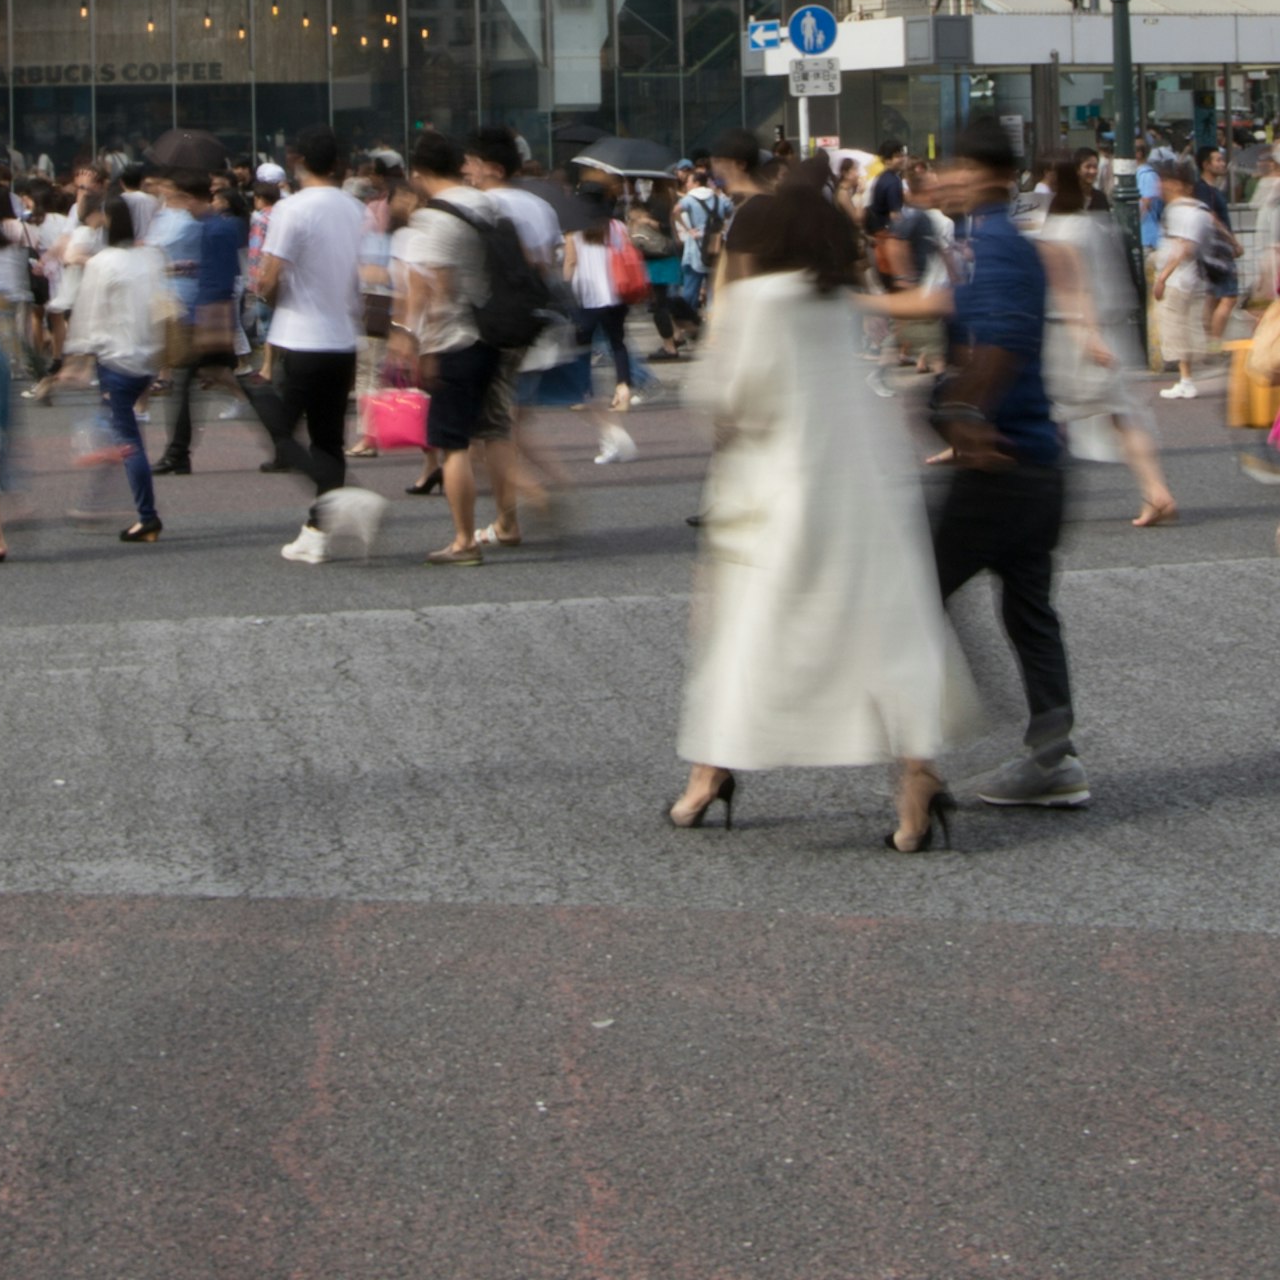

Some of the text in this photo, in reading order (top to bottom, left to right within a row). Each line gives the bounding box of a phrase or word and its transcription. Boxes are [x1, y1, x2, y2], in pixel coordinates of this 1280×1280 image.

[794, 61, 805, 70] 15
[122, 61, 224, 82] COFFEE
[795, 84, 806, 93] 12
